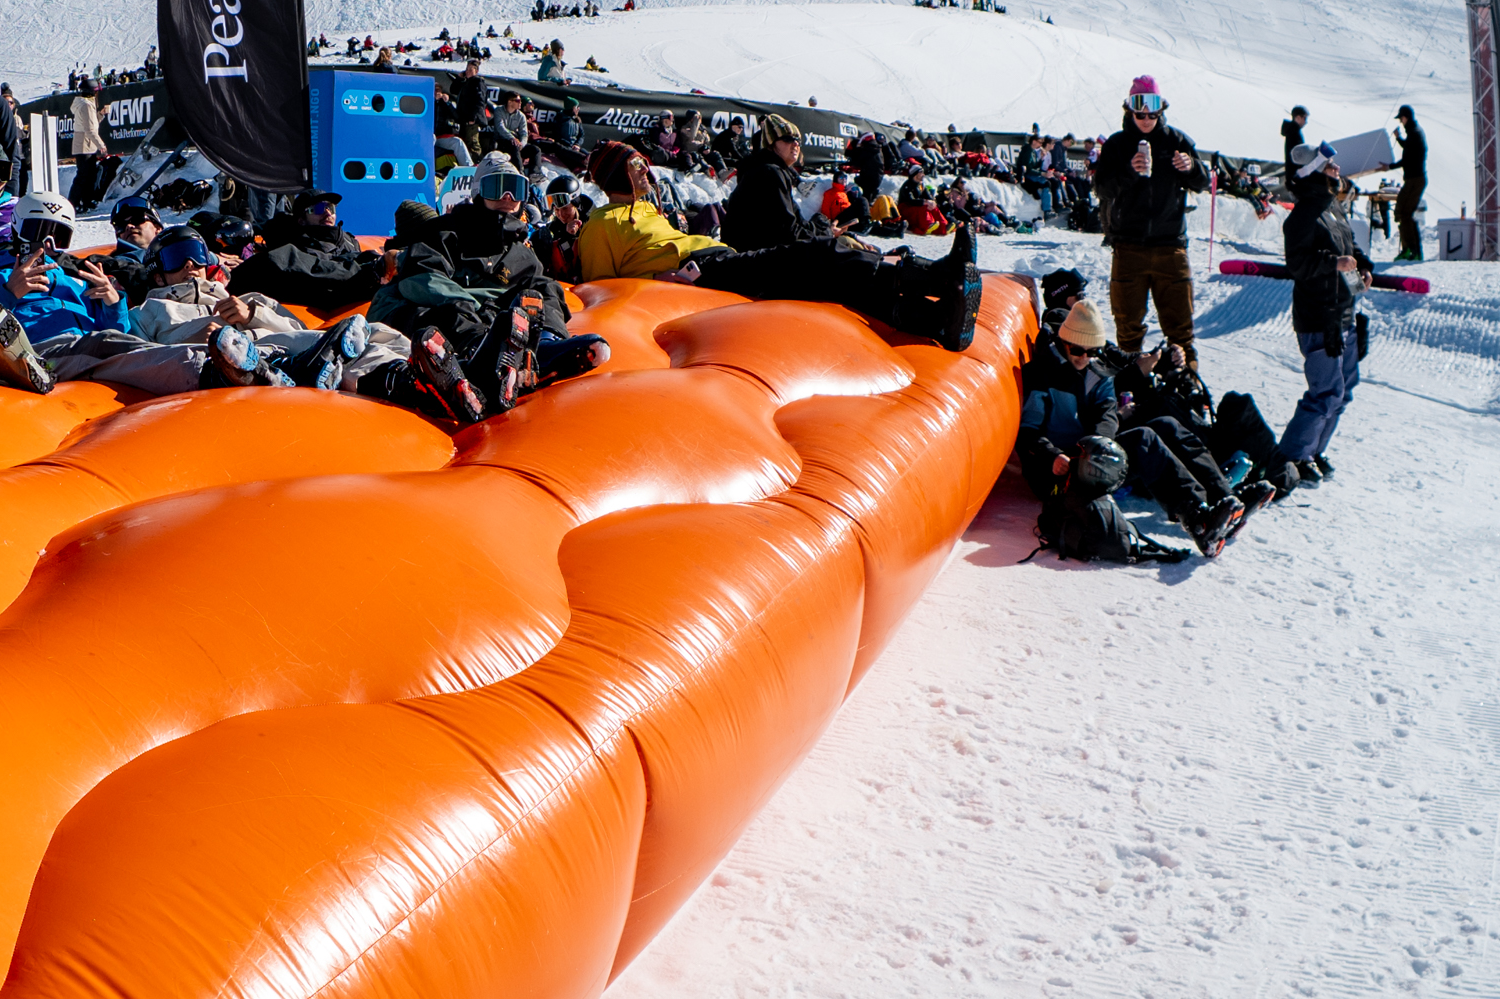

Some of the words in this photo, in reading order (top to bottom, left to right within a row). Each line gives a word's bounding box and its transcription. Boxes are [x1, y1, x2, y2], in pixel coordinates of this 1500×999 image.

[533, 107, 557, 123] IER
[595, 107, 661, 130] Alpina
[805, 132, 845, 150] XTREME
